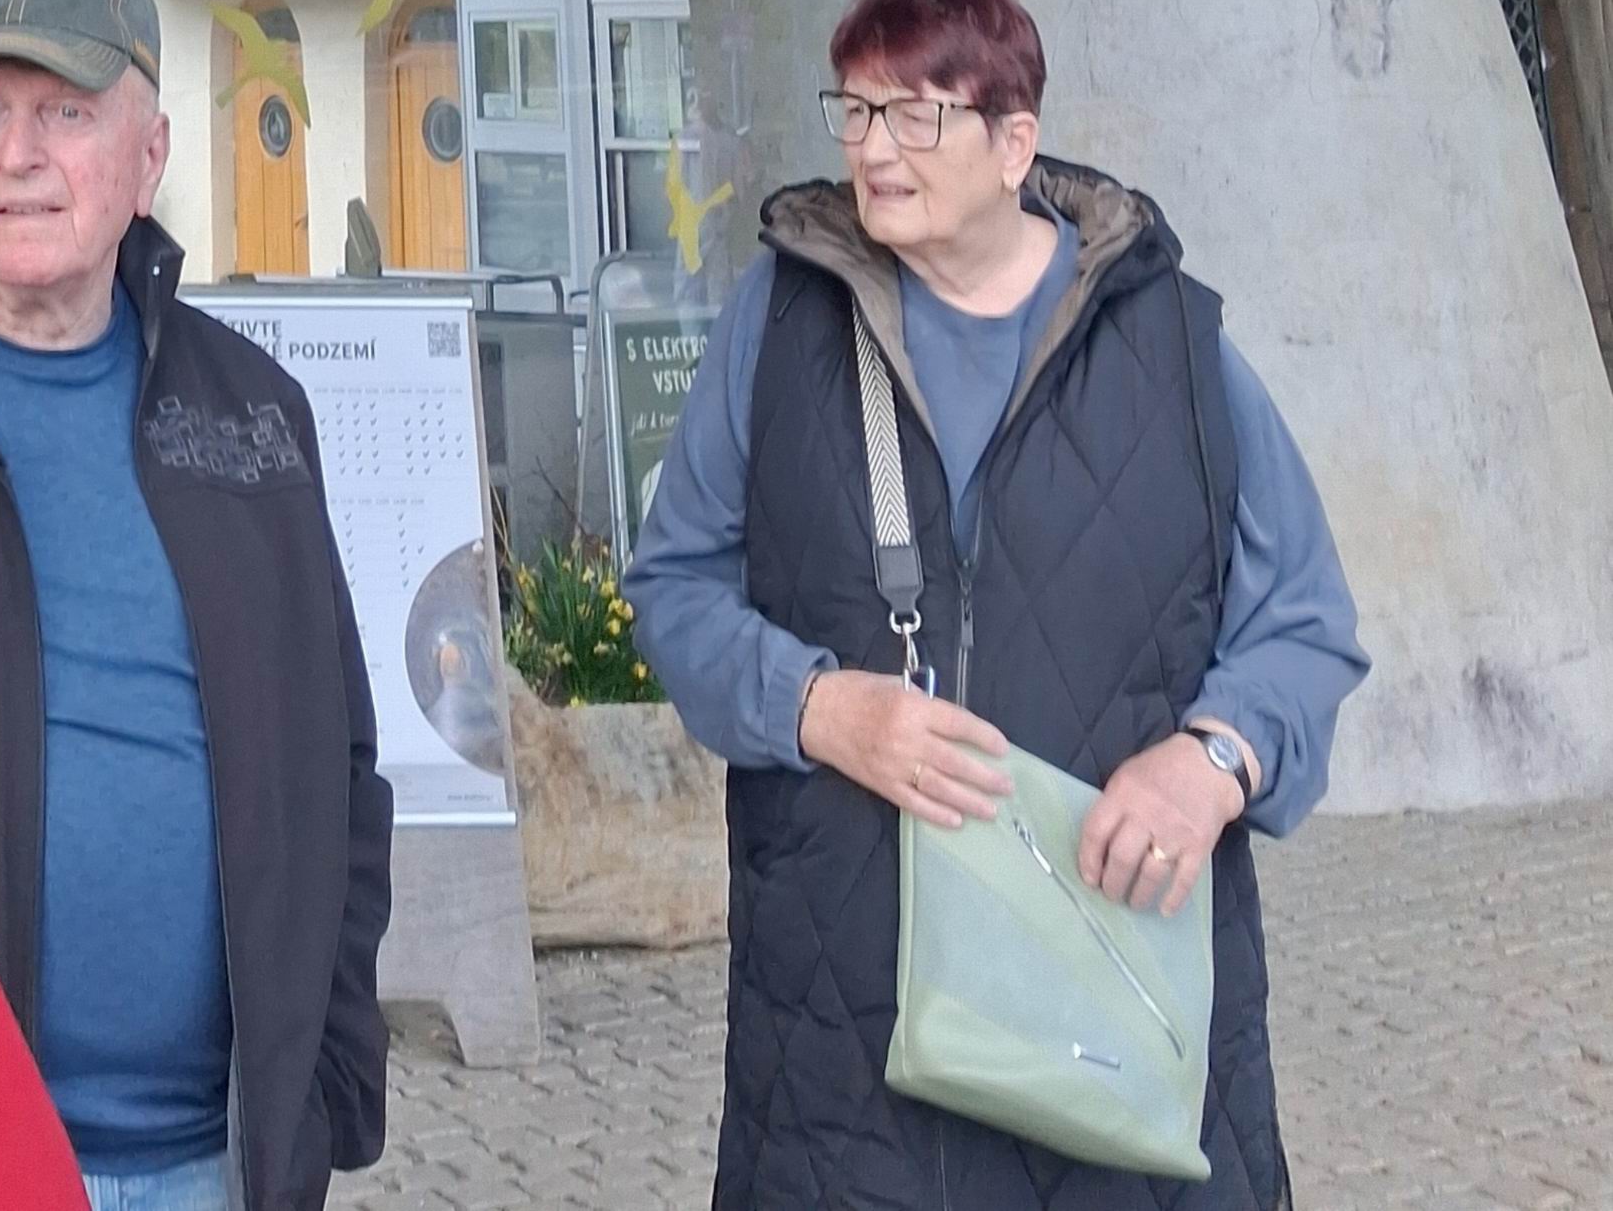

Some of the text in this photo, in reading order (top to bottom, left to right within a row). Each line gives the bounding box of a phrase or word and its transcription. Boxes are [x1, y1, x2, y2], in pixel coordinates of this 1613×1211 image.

[216, 315, 282, 338] TIVTE
[289, 337, 376, 360] PODZEMÍ
[626, 336, 637, 363] S
